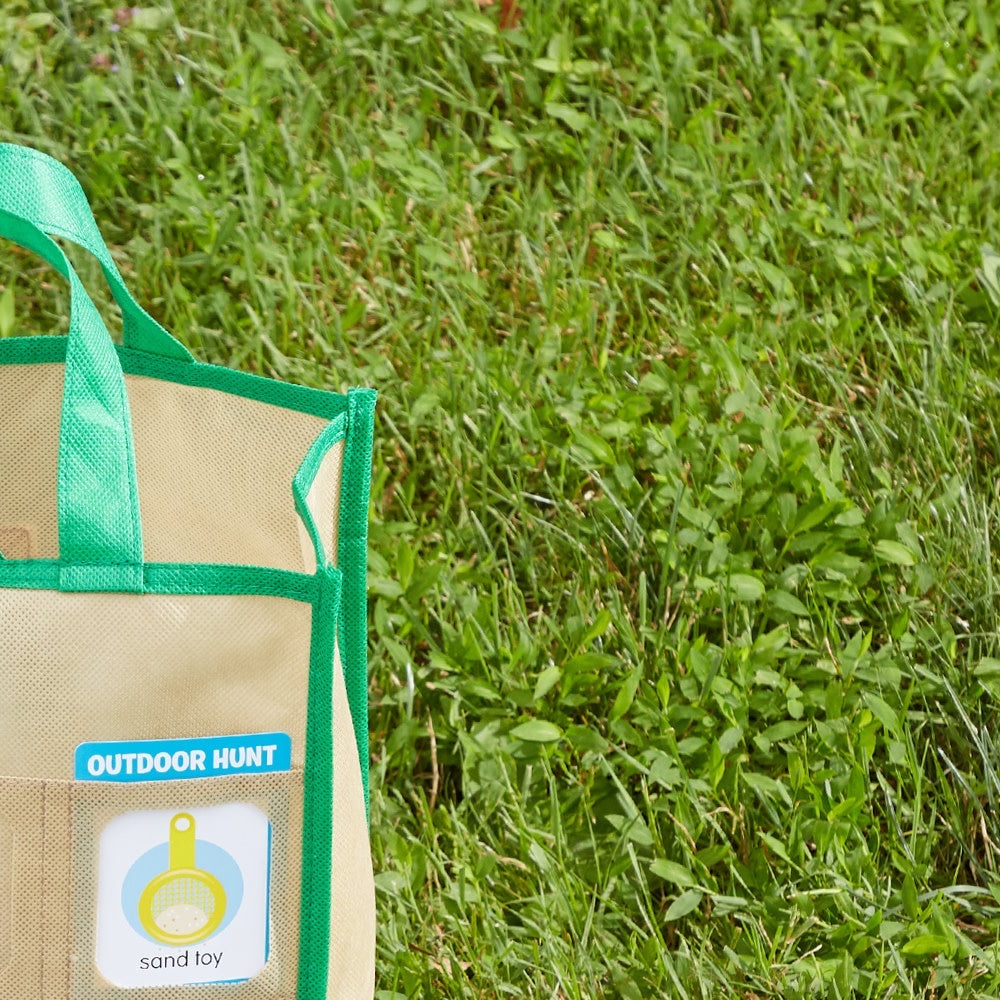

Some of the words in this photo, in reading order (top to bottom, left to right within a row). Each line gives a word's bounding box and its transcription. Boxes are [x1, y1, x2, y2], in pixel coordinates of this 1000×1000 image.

[87, 750, 206, 776] OUTDOOR
[212, 745, 277, 769] HUNT
[140, 951, 188, 969] sand
[194, 951, 223, 968] toy
